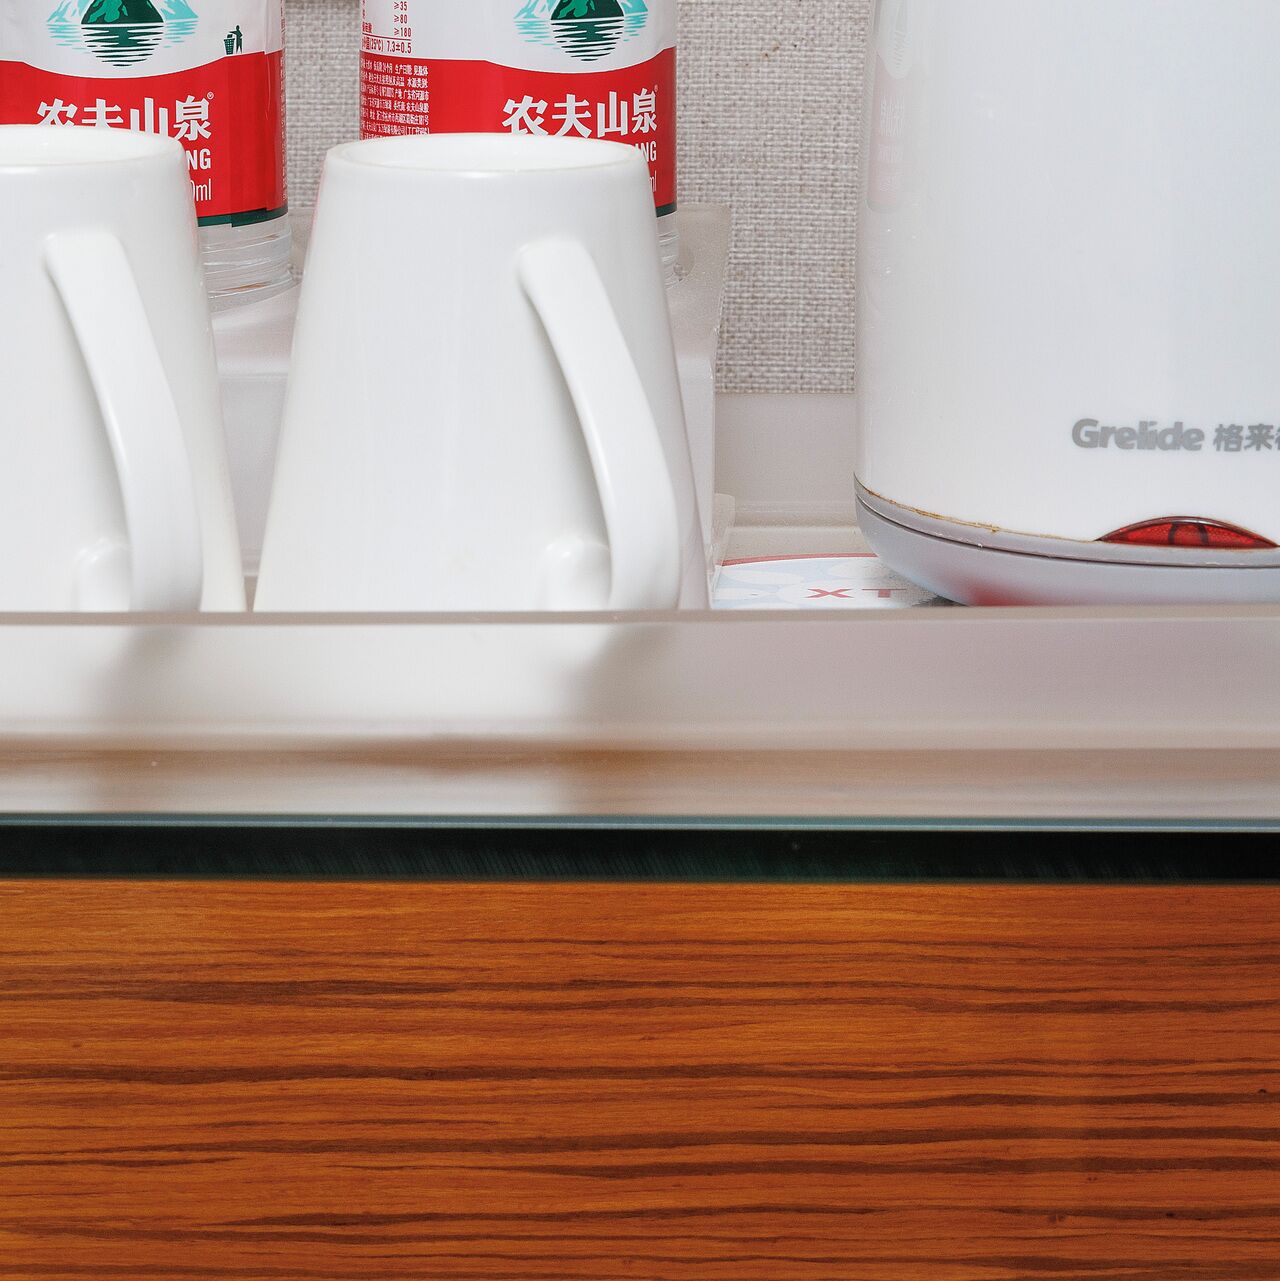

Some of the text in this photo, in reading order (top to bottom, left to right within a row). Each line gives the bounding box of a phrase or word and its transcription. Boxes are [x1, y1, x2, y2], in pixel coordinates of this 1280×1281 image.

[36, 94, 212, 141] 农夫山泉
[502, 87, 658, 139] 农夫山泉
[1071, 418, 1205, 451] Grelide
